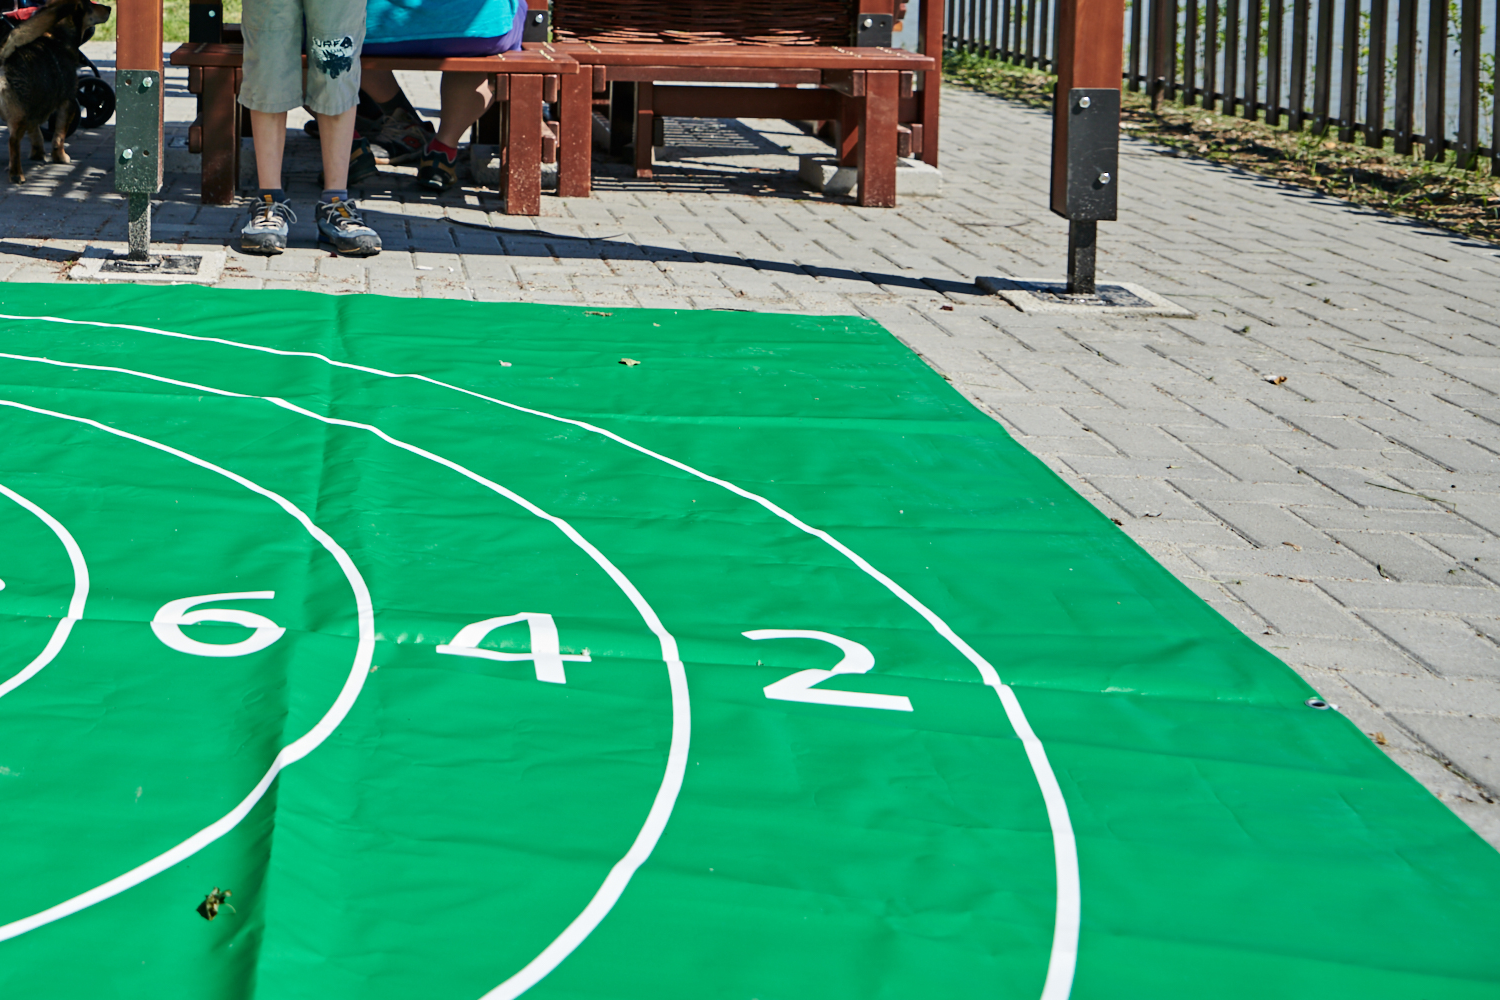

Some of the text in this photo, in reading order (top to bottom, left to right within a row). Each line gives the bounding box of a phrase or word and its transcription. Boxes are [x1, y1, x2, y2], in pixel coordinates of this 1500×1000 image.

[149, 591, 286, 656] 6
[435, 612, 592, 684] 4
[740, 628, 914, 711] 2
